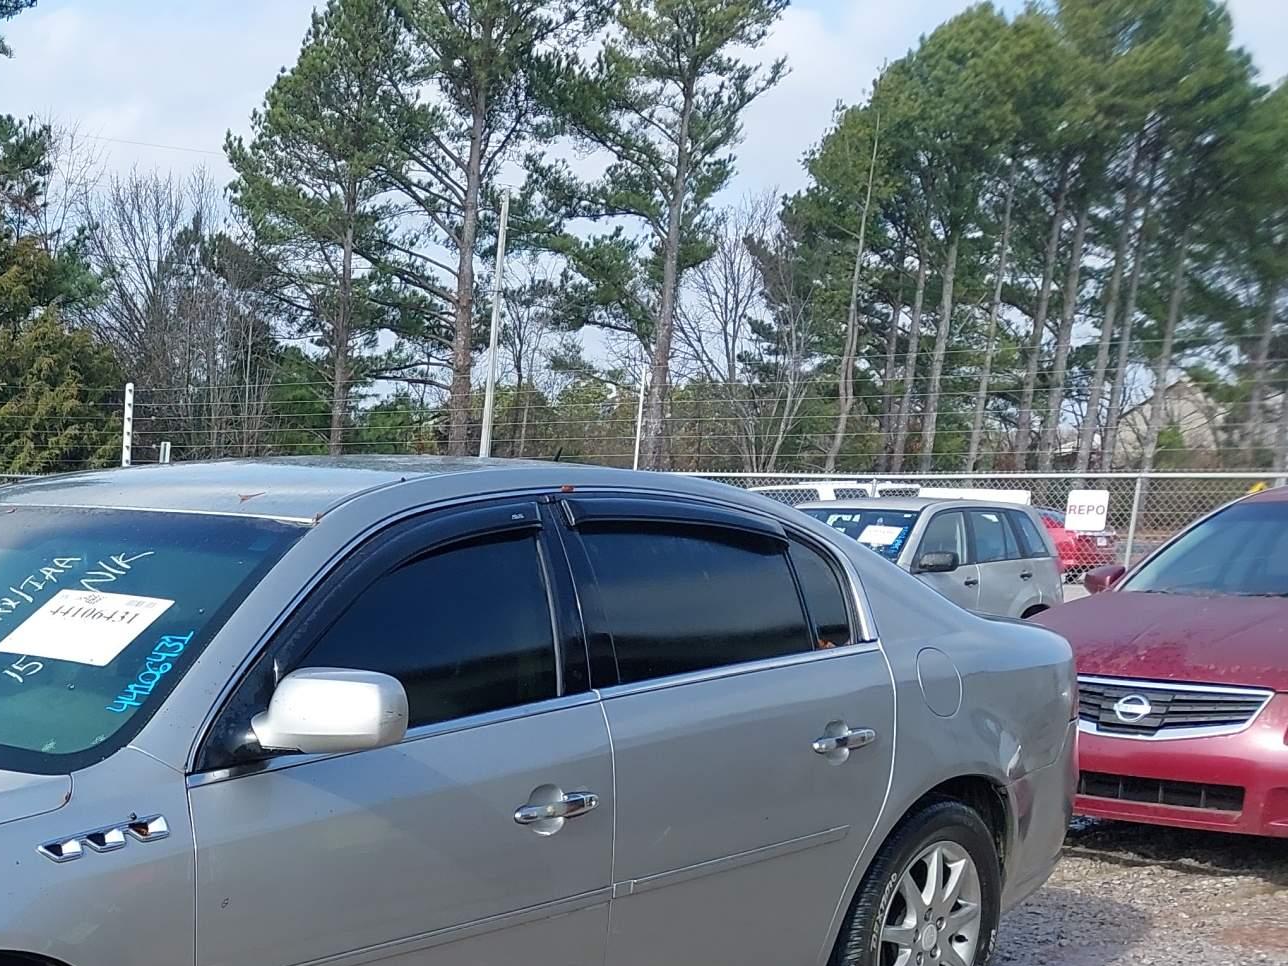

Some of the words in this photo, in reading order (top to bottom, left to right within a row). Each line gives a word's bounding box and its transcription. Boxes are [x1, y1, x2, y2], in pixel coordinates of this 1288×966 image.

[1068, 504, 1106, 515] REPO
[49, 604, 140, 625] 44106431
[2, 655, 43, 683] 15
[105, 631, 195, 712] 44106431
